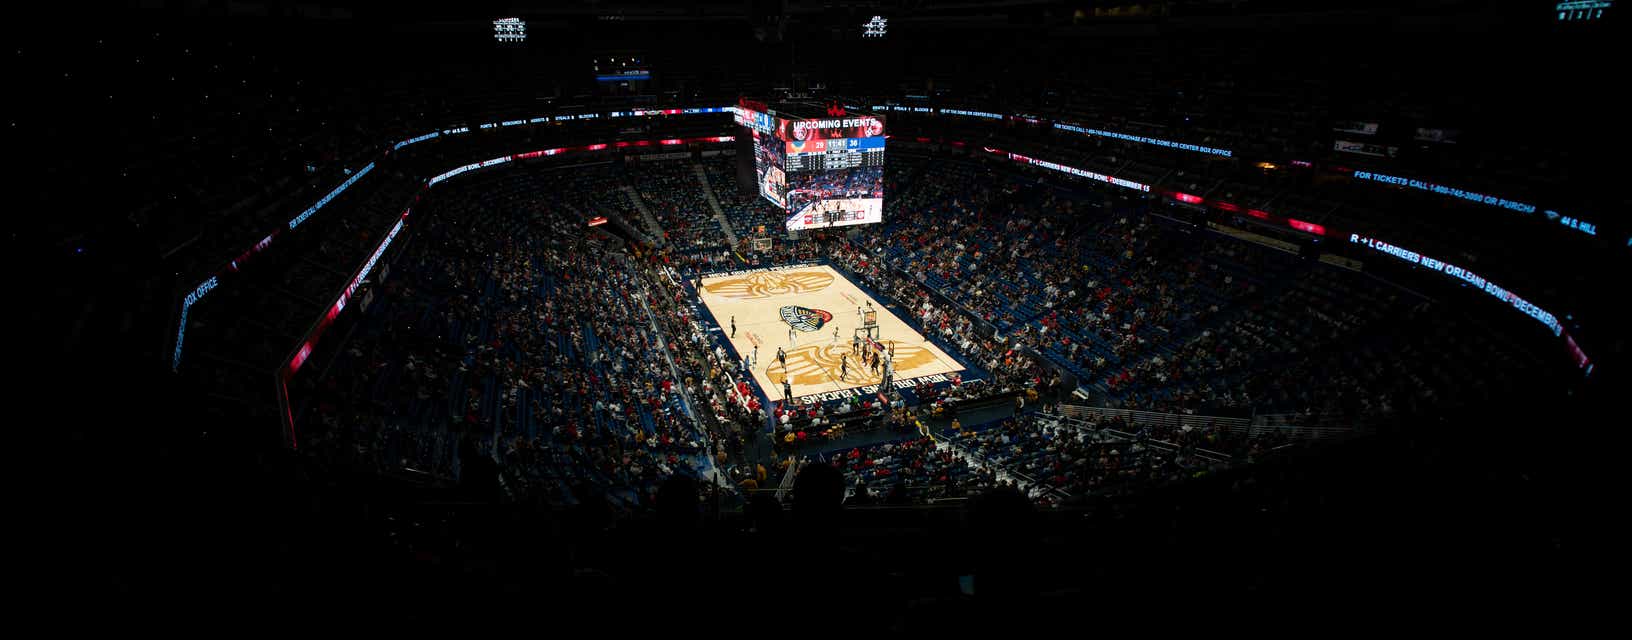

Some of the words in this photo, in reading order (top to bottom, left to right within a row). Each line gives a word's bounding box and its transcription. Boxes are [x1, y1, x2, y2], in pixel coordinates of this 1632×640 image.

[793, 120, 841, 131] UPCOMING
[842, 118, 877, 128] EVENTS
[1156, 139, 1170, 147] DOME
[1179, 143, 1200, 152] CENTER
[1199, 146, 1211, 154] BOX
[1211, 148, 1232, 157] OFFICE
[1039, 160, 1061, 170] CARRIERS
[1060, 165, 1072, 174] NEW
[1071, 167, 1094, 179] ORLEANS
[1093, 173, 1108, 183] BOWL
[1112, 177, 1142, 191] DECEMBER
[1354, 170, 1372, 180] FOR
[1373, 173, 1408, 185] TICKETS
[1409, 179, 1429, 190] CALL
[1484, 195, 1498, 206] OR
[1560, 215, 1571, 226] 44
[1570, 218, 1579, 229] S.
[1578, 221, 1597, 236] HILL
[1350, 233, 1359, 243] R
[1368, 238, 1375, 248] L
[1375, 240, 1420, 263] CARRIERS
[1421, 255, 1445, 271] NEW
[1445, 264, 1486, 290] ORLEANS
[1485, 281, 1509, 303] BOWL
[196, 276, 219, 298] OFFICE
[801, 389, 855, 405] ELICANS
[864, 379, 916, 395] ORLNS
